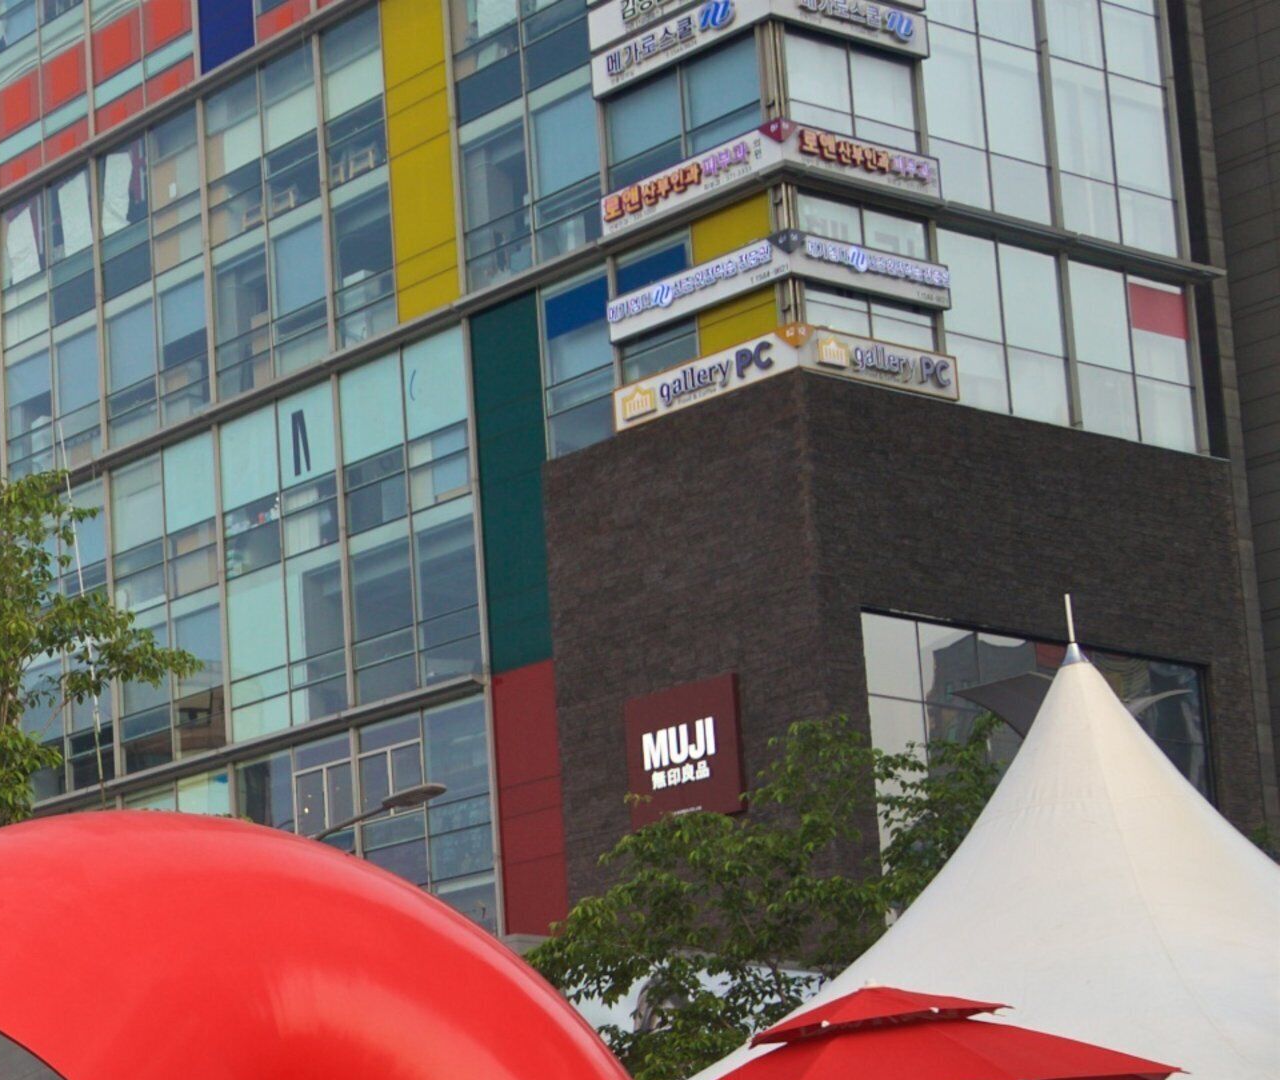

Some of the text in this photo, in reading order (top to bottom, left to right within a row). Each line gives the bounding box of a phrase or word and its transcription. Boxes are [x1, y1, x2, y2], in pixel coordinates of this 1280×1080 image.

[659, 358, 731, 406] gallery
[734, 341, 773, 378] PC
[854, 344, 952, 387] gallery PC
[642, 716, 716, 772] MUJI
[651, 760, 711, 790] 無印良品
